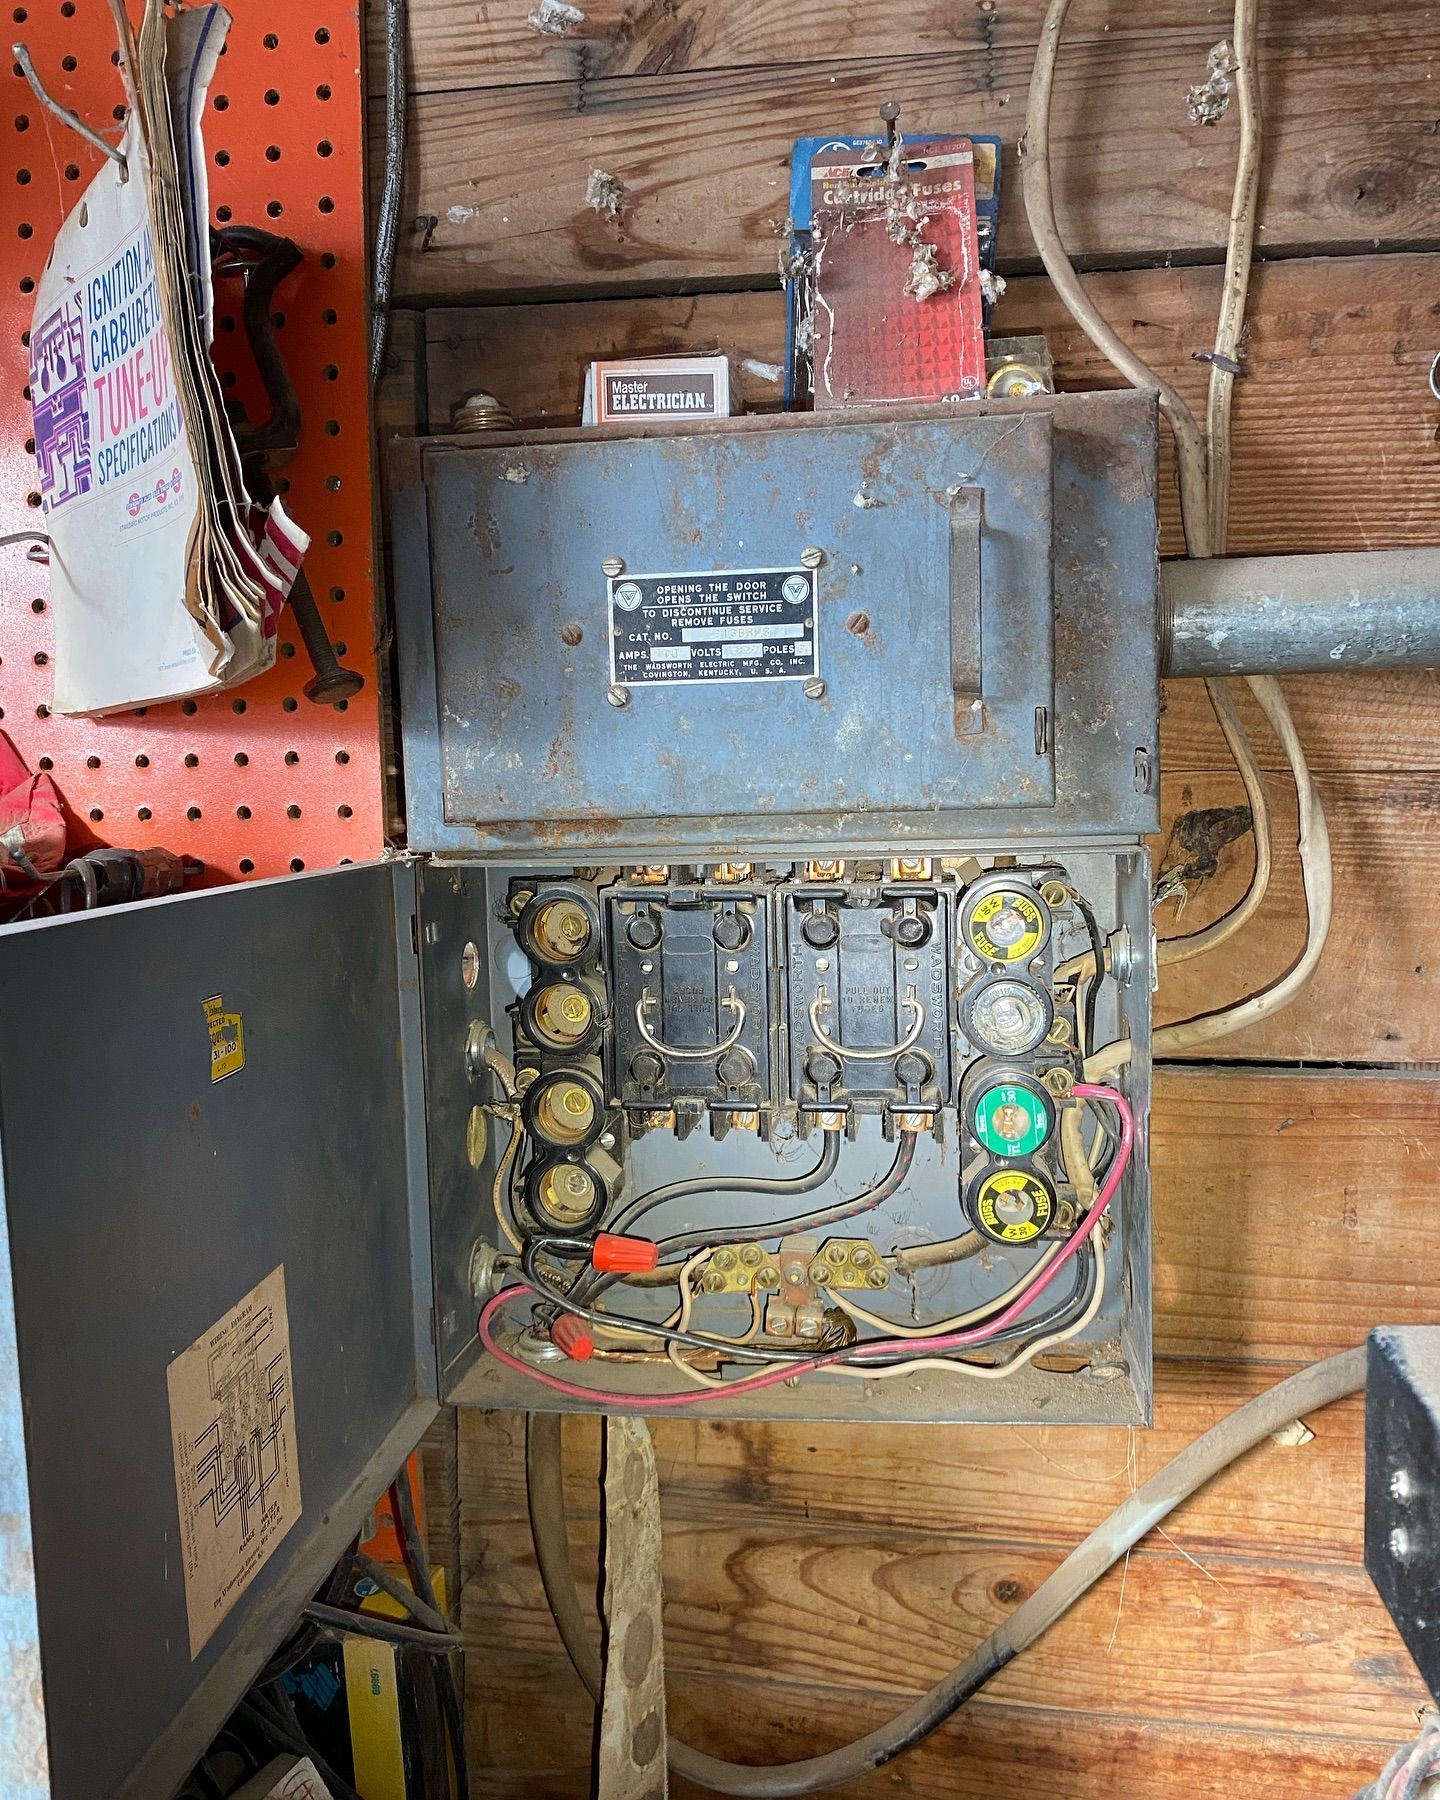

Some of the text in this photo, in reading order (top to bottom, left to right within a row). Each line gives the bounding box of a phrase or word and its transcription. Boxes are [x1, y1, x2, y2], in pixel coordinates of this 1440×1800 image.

[913, 180, 962, 196] Fuses
[88, 241, 142, 324] IGNITION
[94, 325, 171, 443] TUNE-UP
[612, 381, 648, 394] Master
[612, 392, 706, 411] ELECTRICIAN
[98, 405, 177, 486] SPECIFICATIONS
[656, 581, 767, 595] OPENING THE DOOR
[656, 591, 767, 605] OPENS THE SWITCH
[643, 604, 783, 619] TO DISCONTINUE SERVICE
[671, 615, 754, 627] REMOVE FUSES
[628, 632, 651, 642] CAT.
[654, 631, 673, 641] NO.
[618, 649, 650, 660] AMPS.
[691, 647, 721, 657] VOLTS
[763, 644, 795, 654] POLES
[645, 662, 693, 670] WADSWORTH
[742, 659, 762, 667] MFG.
[642, 670, 691, 679] COVINGTON,
[698, 669, 742, 677] KENTUCKY,
[980, 905, 991, 915] 30
[1012, 898, 1037, 923] BUSS
[975, 930, 999, 957] FUSE
[845, 985, 891, 995] PULL OUT
[792, 944, 804, 1061] WADSWORTH
[931, 942, 944, 1060] WADSWORTH
[1007, 1090, 1017, 1103] 30
[1012, 1142, 1021, 1155] TL
[1032, 1189, 1048, 1217] FUSE
[982, 1198, 998, 1226] BUSS
[1008, 1227, 1017, 1238] W
[1018, 1226, 1027, 1236] 30
[259, 1505, 280, 1536] HEATER
[261, 1500, 277, 1525] WATER
[239, 1528, 255, 1554] RANGE
